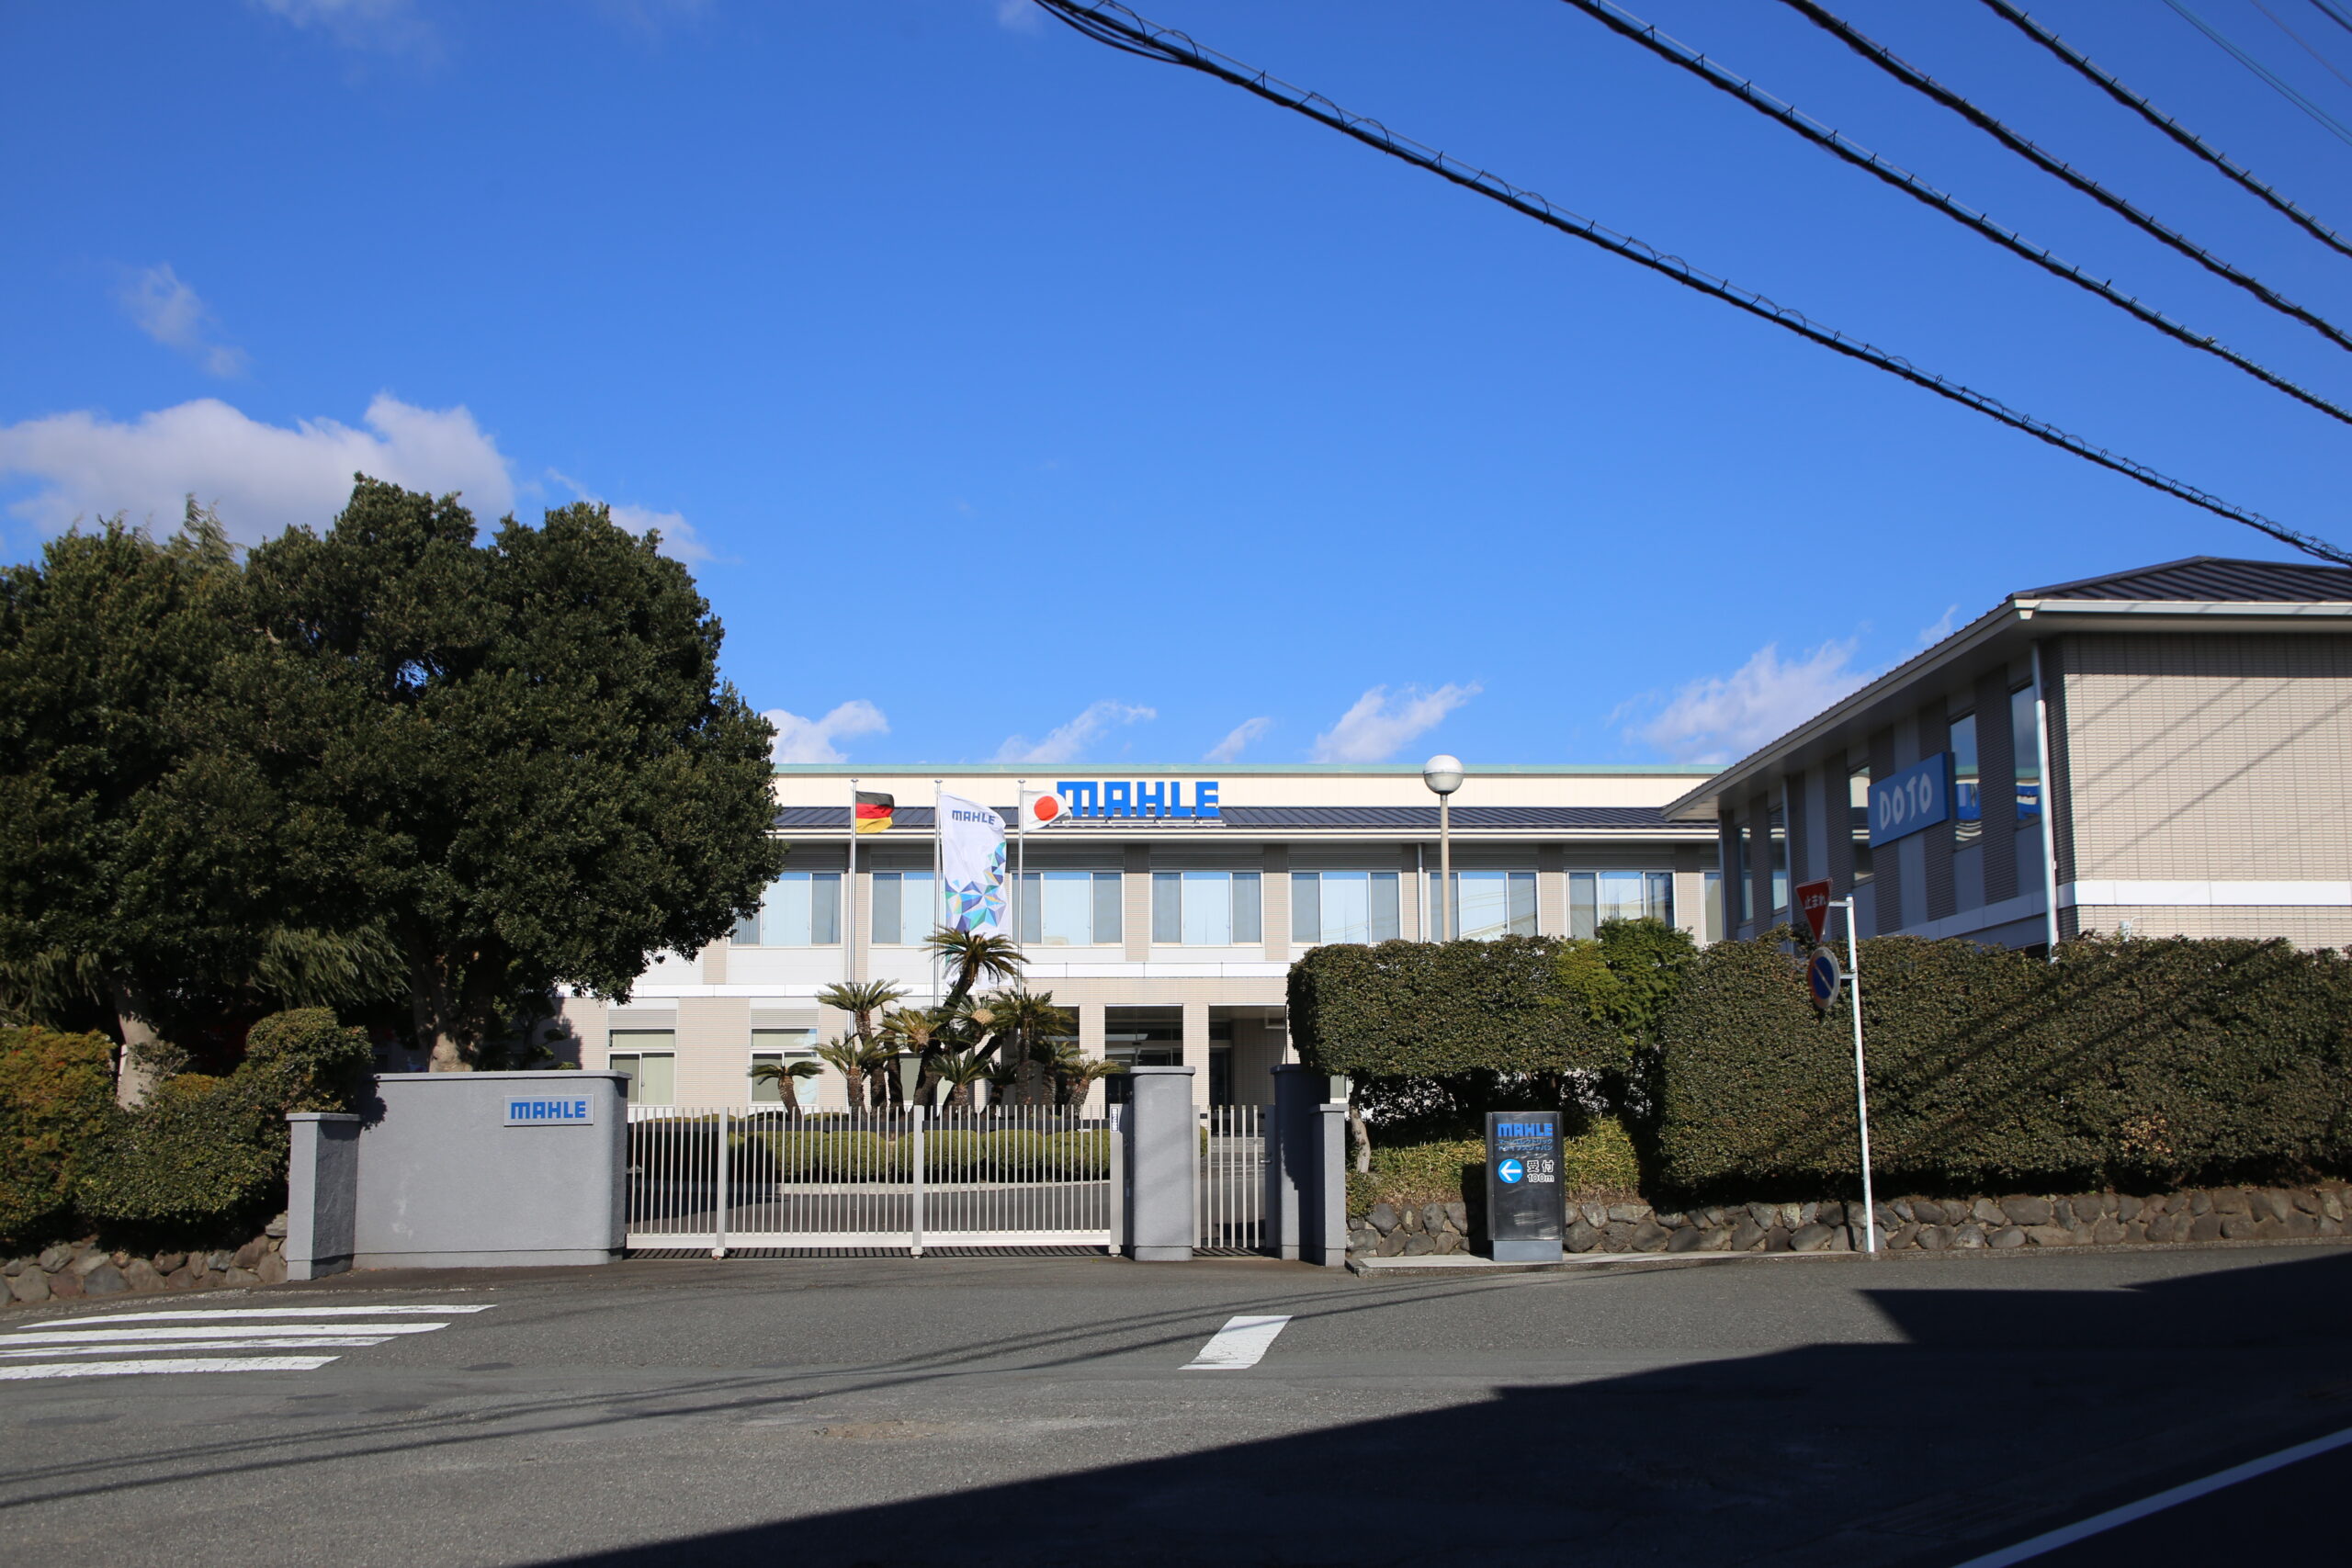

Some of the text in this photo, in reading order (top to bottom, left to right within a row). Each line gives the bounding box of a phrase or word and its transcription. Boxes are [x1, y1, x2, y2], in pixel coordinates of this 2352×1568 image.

[1057, 782, 1218, 817] MAHLE
[952, 809, 995, 825] MAHLE
[1804, 893, 1826, 909] 止まれ
[511, 1101, 586, 1119] MAHLE
[1498, 1123, 1553, 1137] MAHLE
[1527, 1159, 1555, 1172] 受付
[1527, 1173, 1555, 1183] 100m
